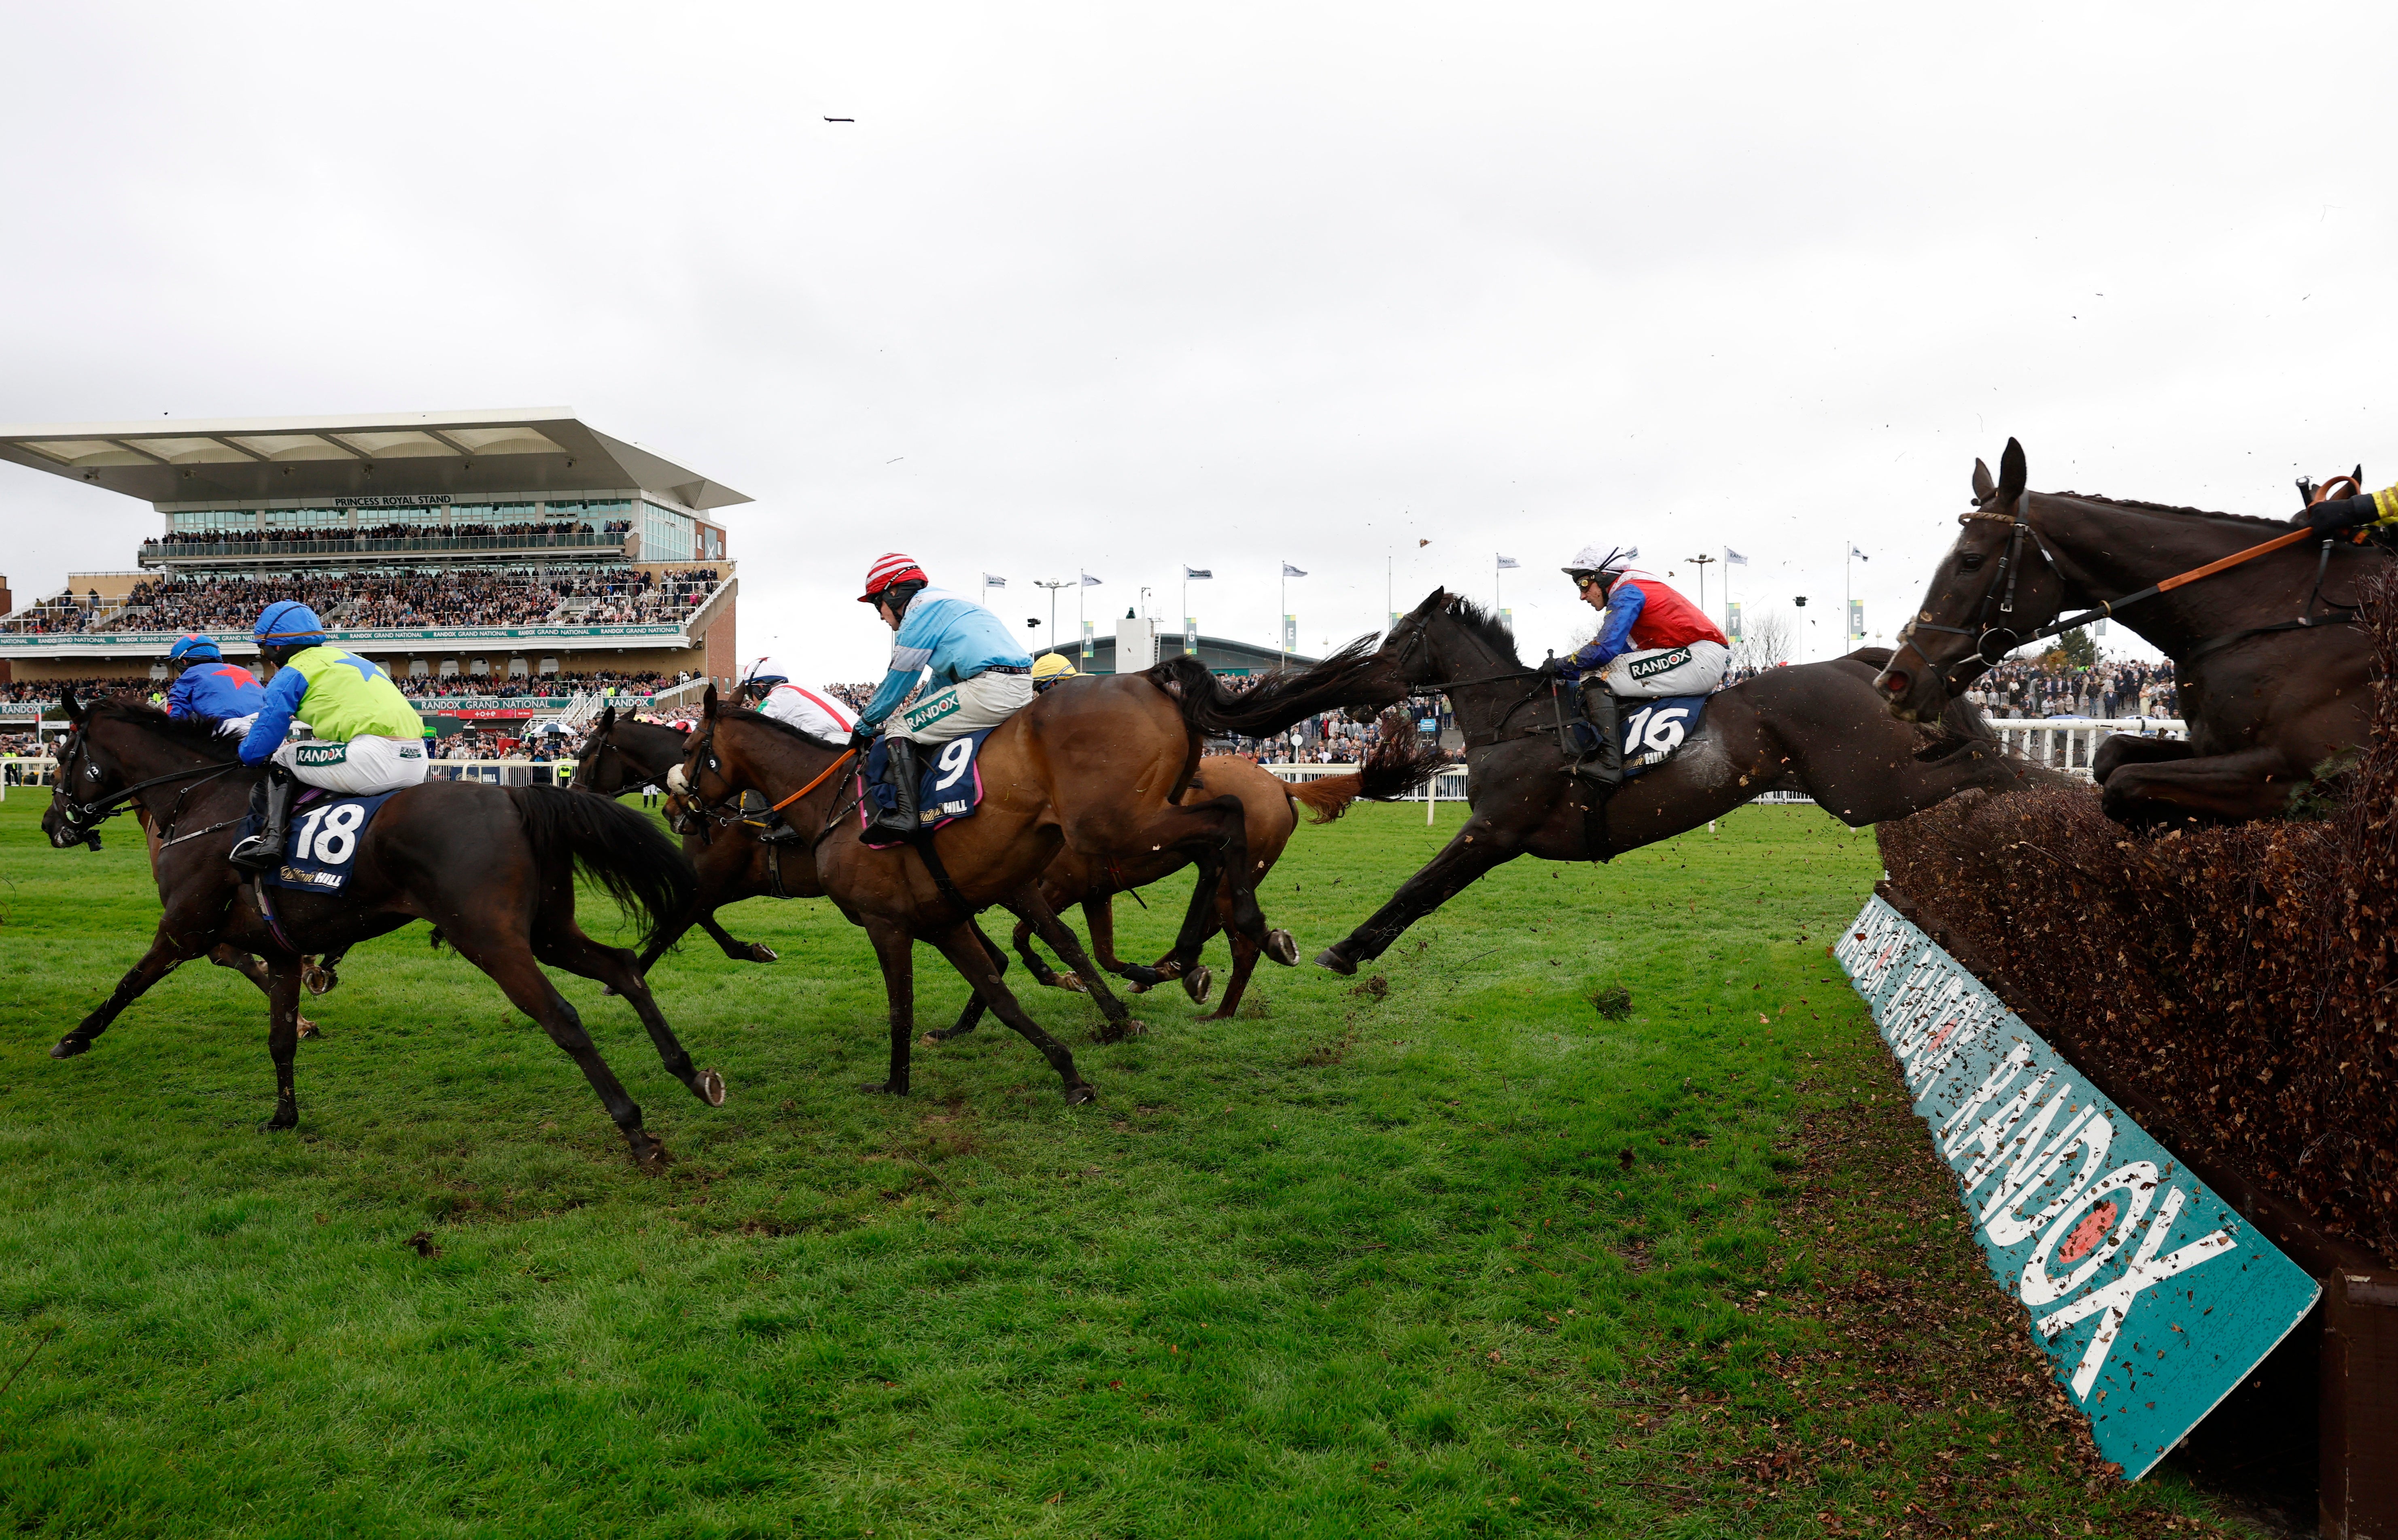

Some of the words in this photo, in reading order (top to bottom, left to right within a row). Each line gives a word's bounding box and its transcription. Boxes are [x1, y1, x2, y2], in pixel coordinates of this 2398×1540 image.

[335, 497, 380, 506] PRINCESS
[383, 496, 415, 505] ROYAL
[419, 495, 451, 504] STAND
[1731, 616, 1738, 628] T
[1854, 614, 1860, 626] E
[1086, 634, 1091, 645] D
[1188, 630, 1195, 642] G
[1288, 628, 1293, 639] E
[1631, 649, 1691, 677] RANDOX
[421, 701, 461, 710] RANDOX
[466, 700, 499, 709] GRAND
[503, 700, 550, 708] NATIONAL
[609, 698, 649, 707] RANDOX
[2, 706, 39, 714] RANDOX
[906, 694, 959, 730] RANDOX
[1624, 707, 1689, 754] 16
[297, 747, 345, 762] RANDOX
[709, 759, 716, 768] 9
[936, 738, 973, 791] 9
[483, 774, 497, 783] HILL
[943, 799, 968, 814] HILL
[296, 804, 365, 864] 18
[314, 872, 343, 887] HILL
[1835, 899, 1917, 1003] RANDOX
[1880, 949, 2001, 1102] RANDOX
[1936, 1041, 2238, 1404] RANDOX
